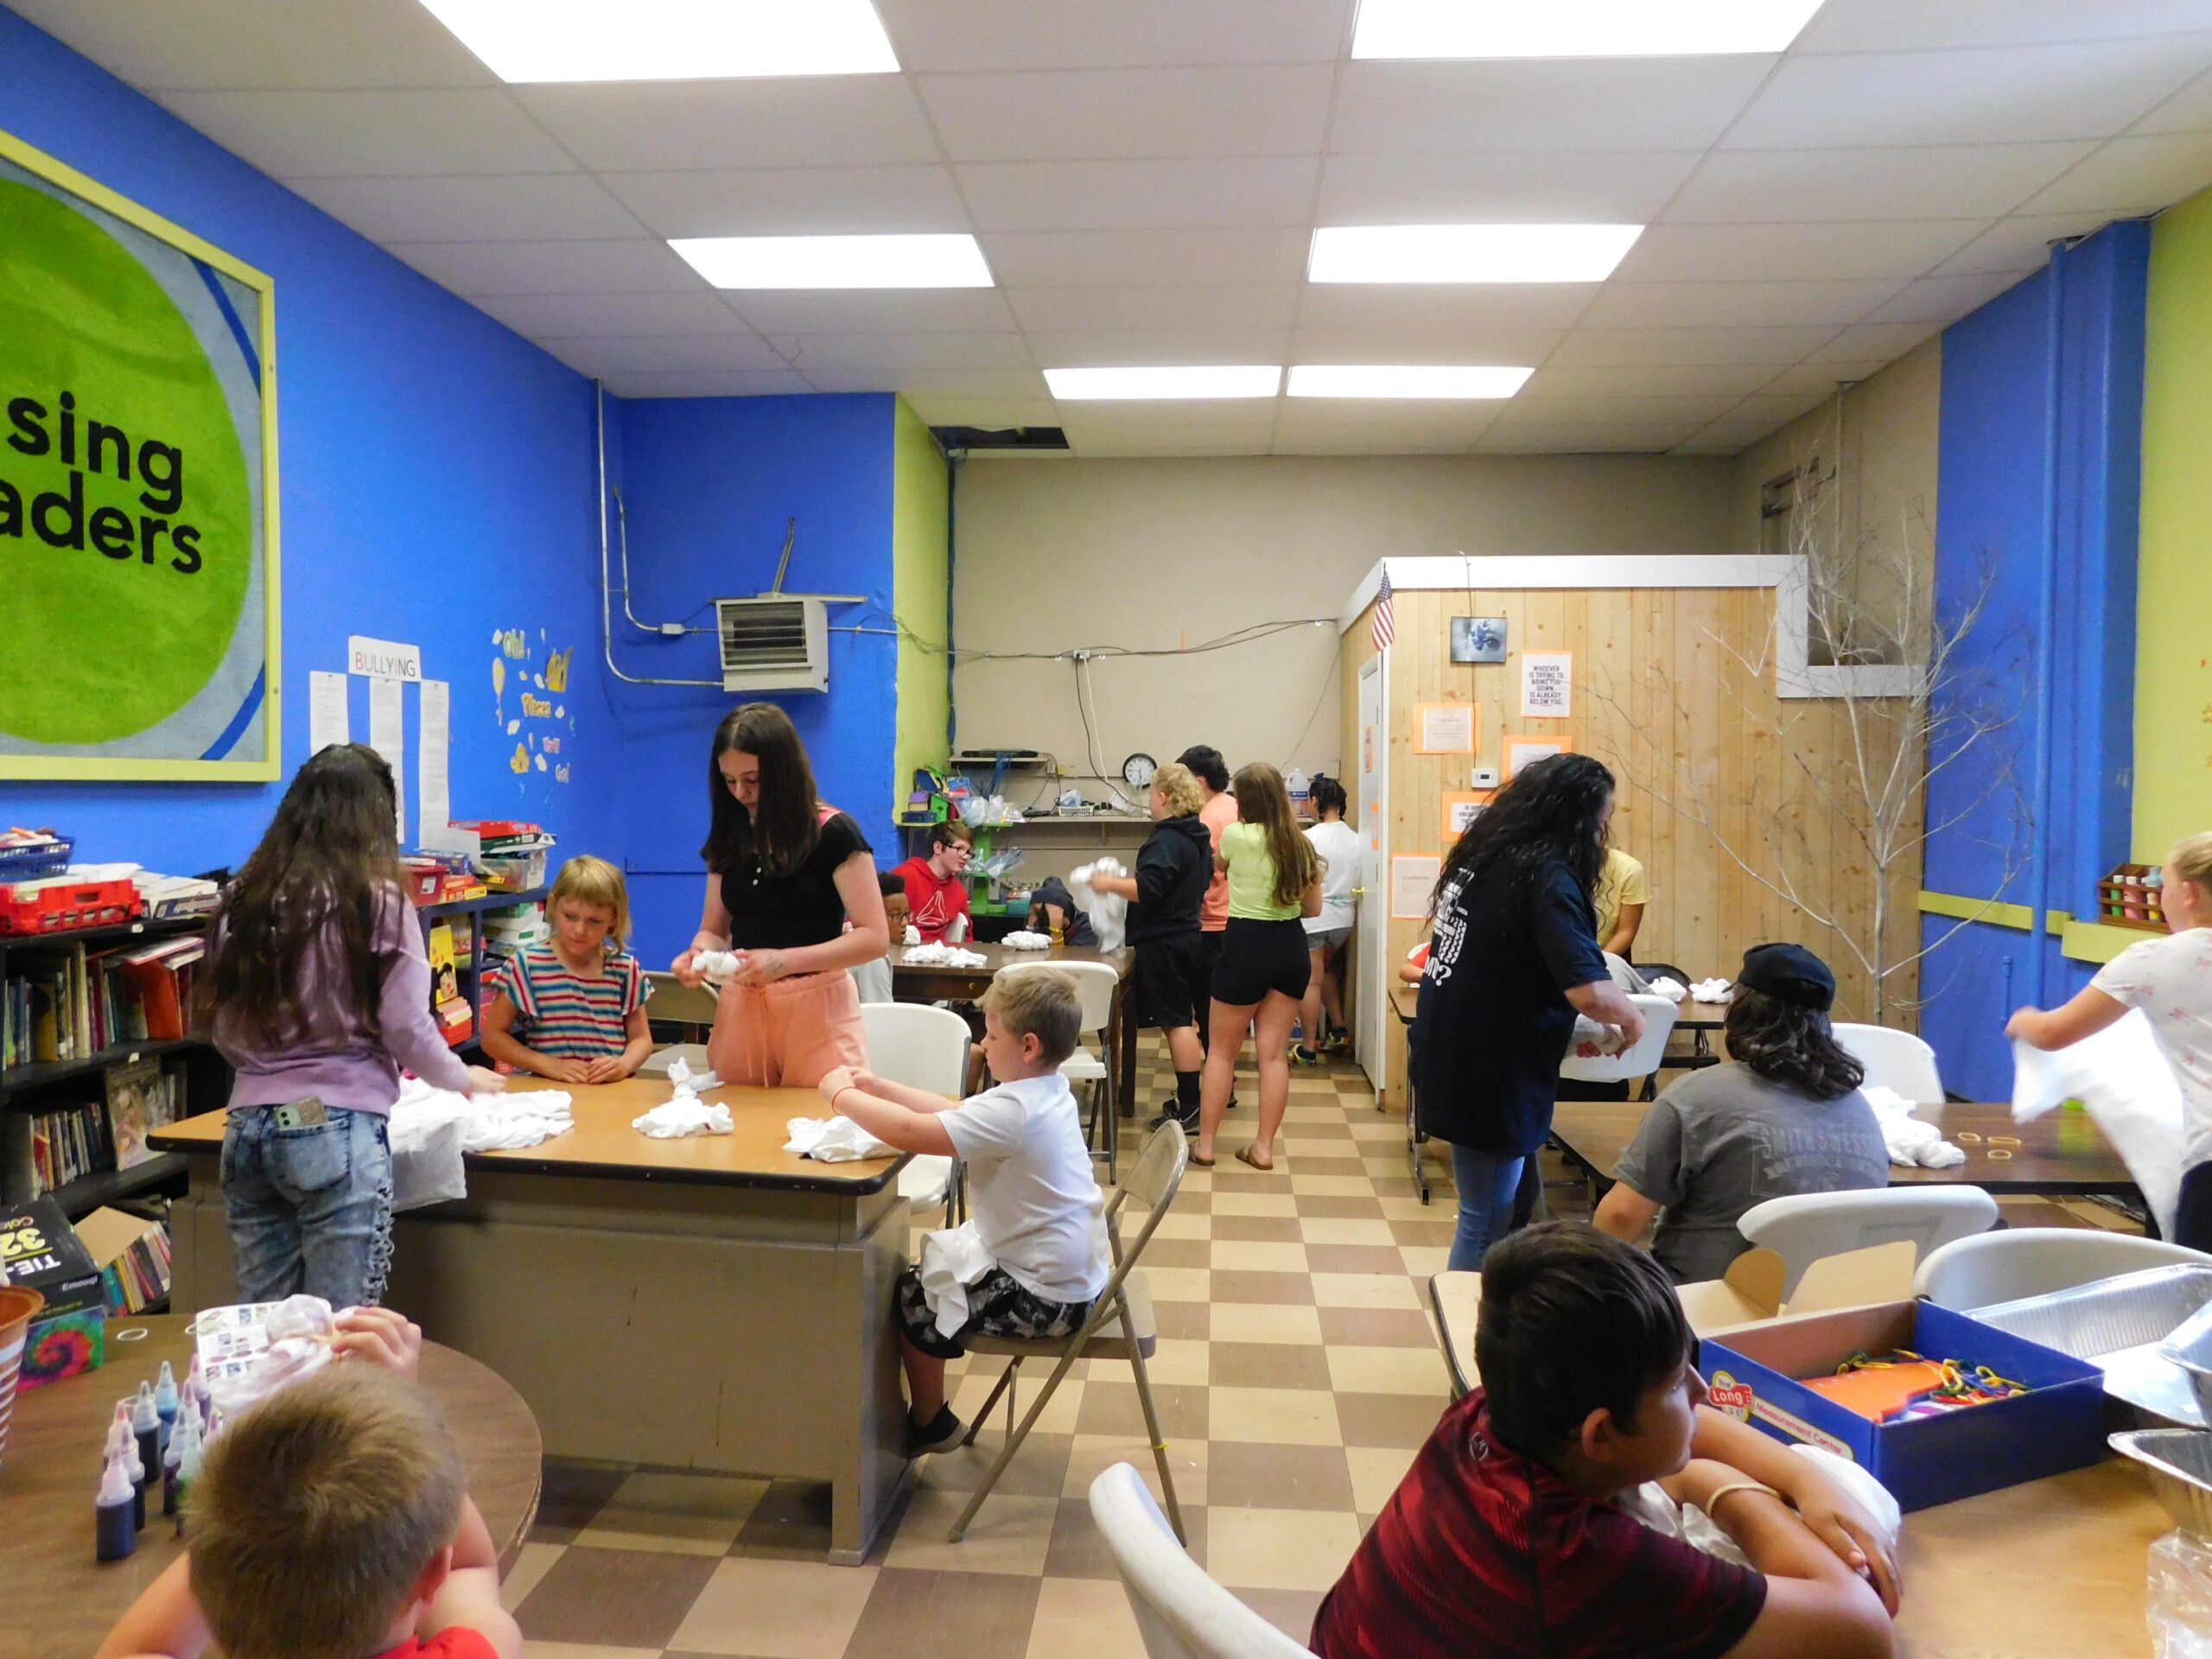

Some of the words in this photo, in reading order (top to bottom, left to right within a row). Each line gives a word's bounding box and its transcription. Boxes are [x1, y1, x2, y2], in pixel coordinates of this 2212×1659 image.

[7, 391, 182, 514] sing
[355, 652, 416, 677] BULLYING
[1712, 1388, 1744, 1406] Long
[1755, 1402, 1811, 1438] Measurement
[1813, 1433, 1843, 1454] Center
